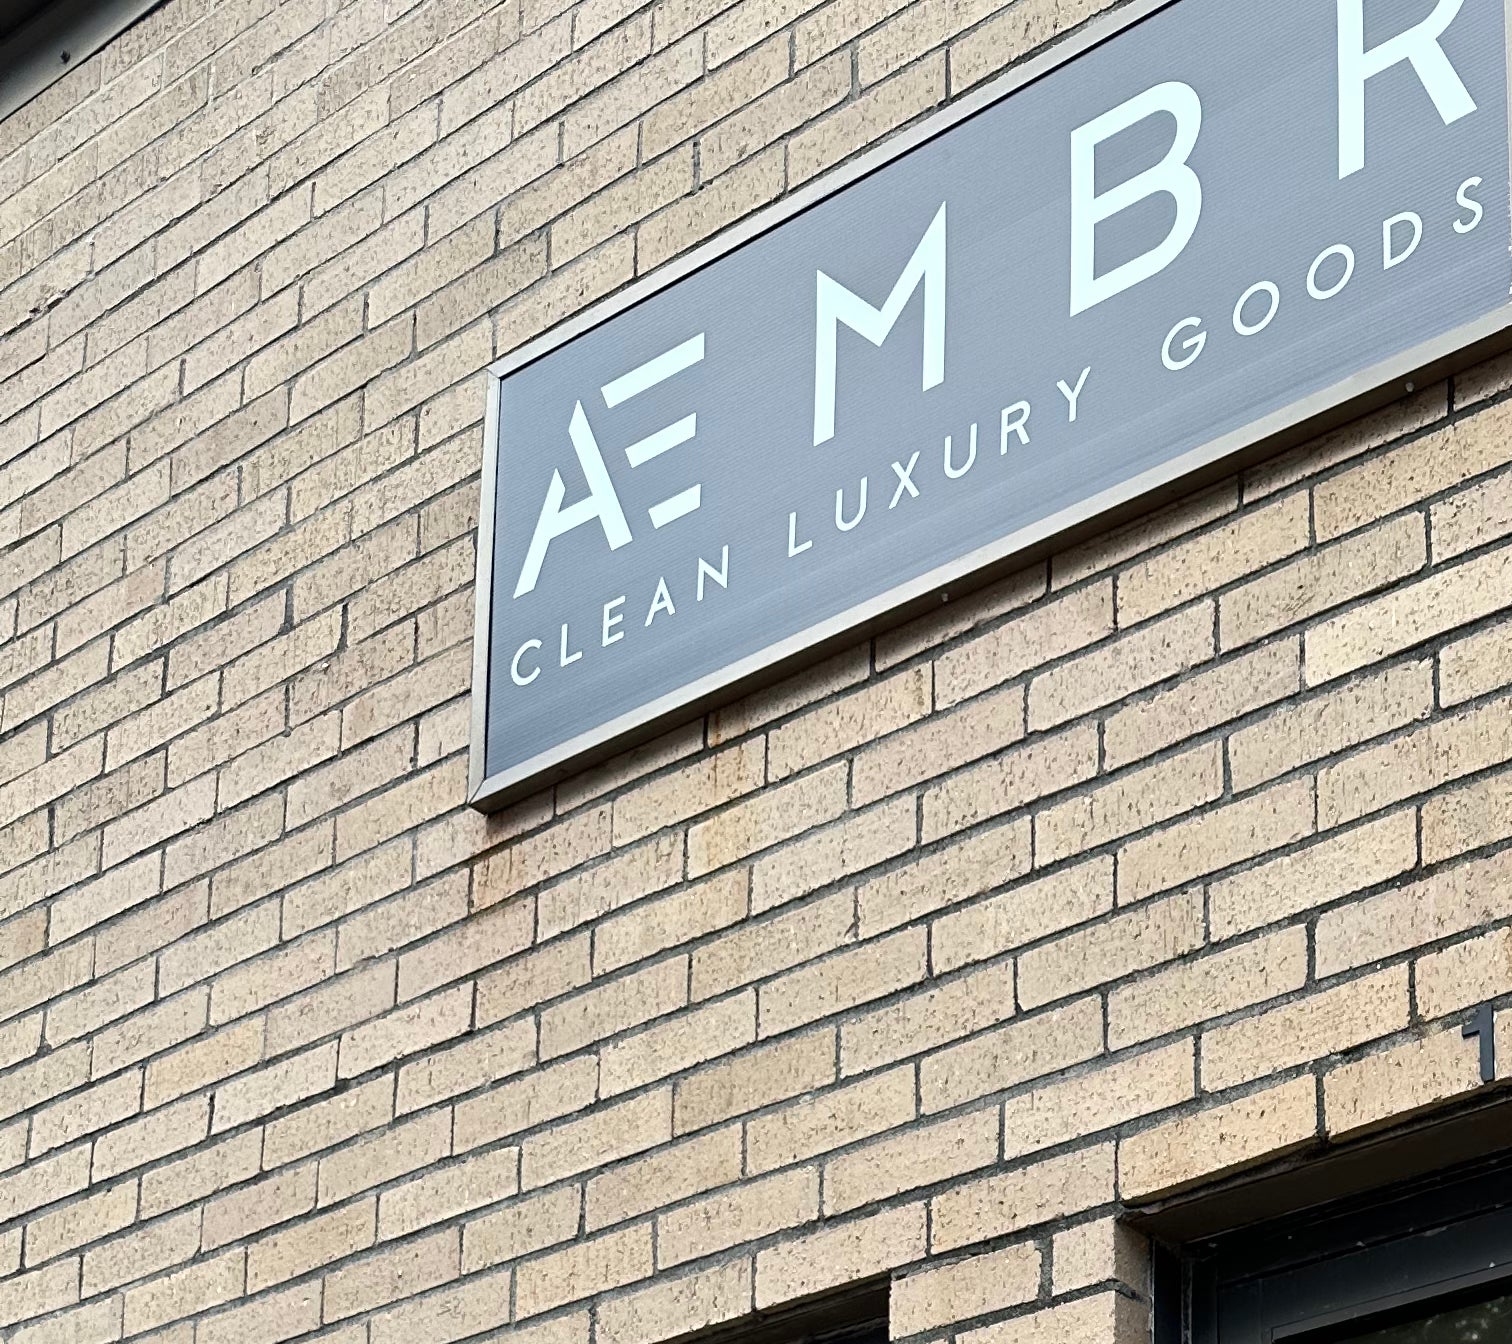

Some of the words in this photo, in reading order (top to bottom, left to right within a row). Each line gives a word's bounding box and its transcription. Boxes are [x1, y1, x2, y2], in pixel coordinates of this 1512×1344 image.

[510, 544, 731, 688] CLEAN
[787, 366, 1092, 558] LUXURY
[1161, 175, 1487, 372] GOODS
